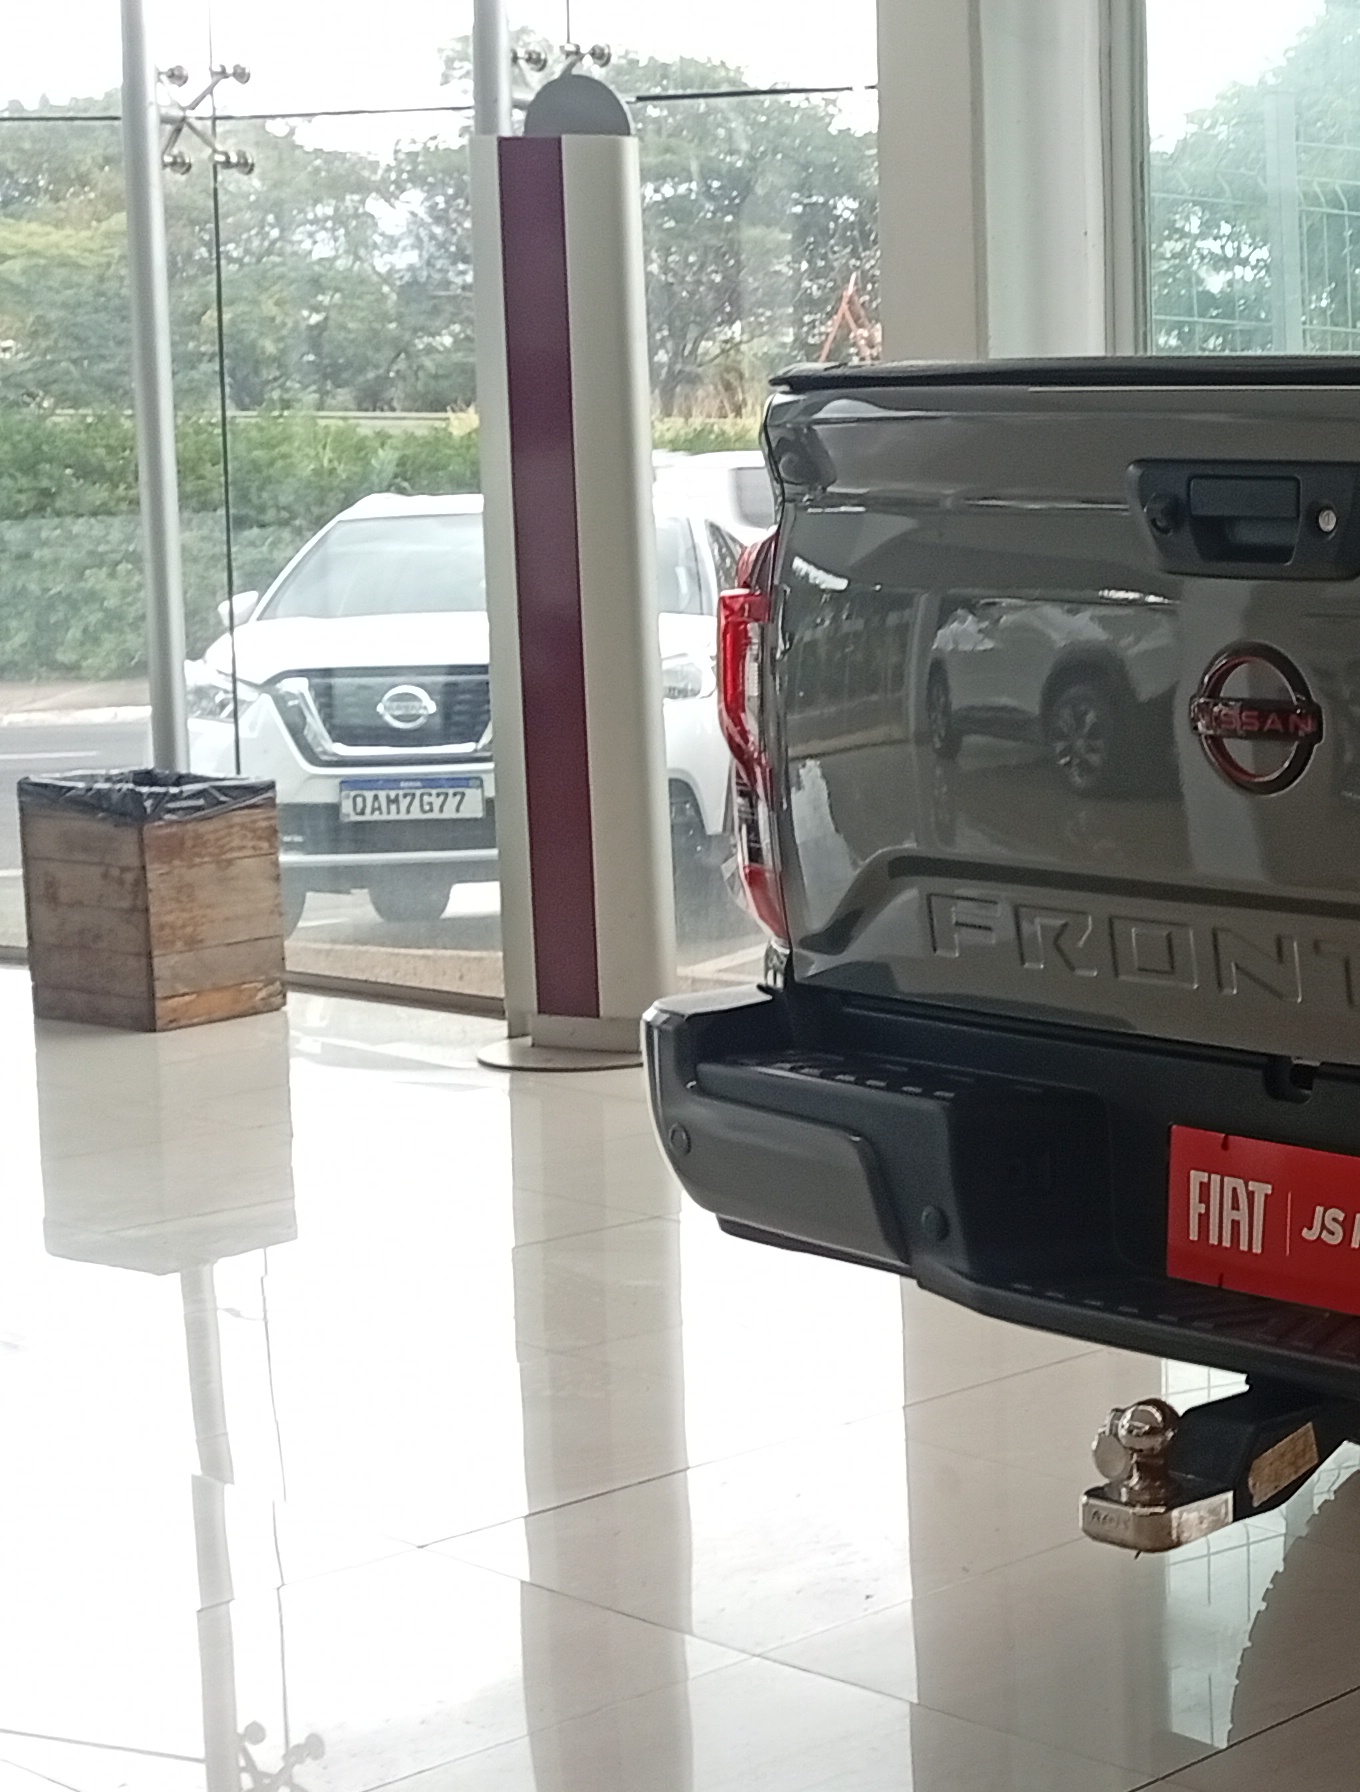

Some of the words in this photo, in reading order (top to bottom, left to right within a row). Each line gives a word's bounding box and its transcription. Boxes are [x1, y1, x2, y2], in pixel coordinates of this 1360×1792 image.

[351, 790, 466, 816] QAM7G77
[1188, 1169, 1273, 1255] FIAT
[1301, 1205, 1346, 1246] JS
